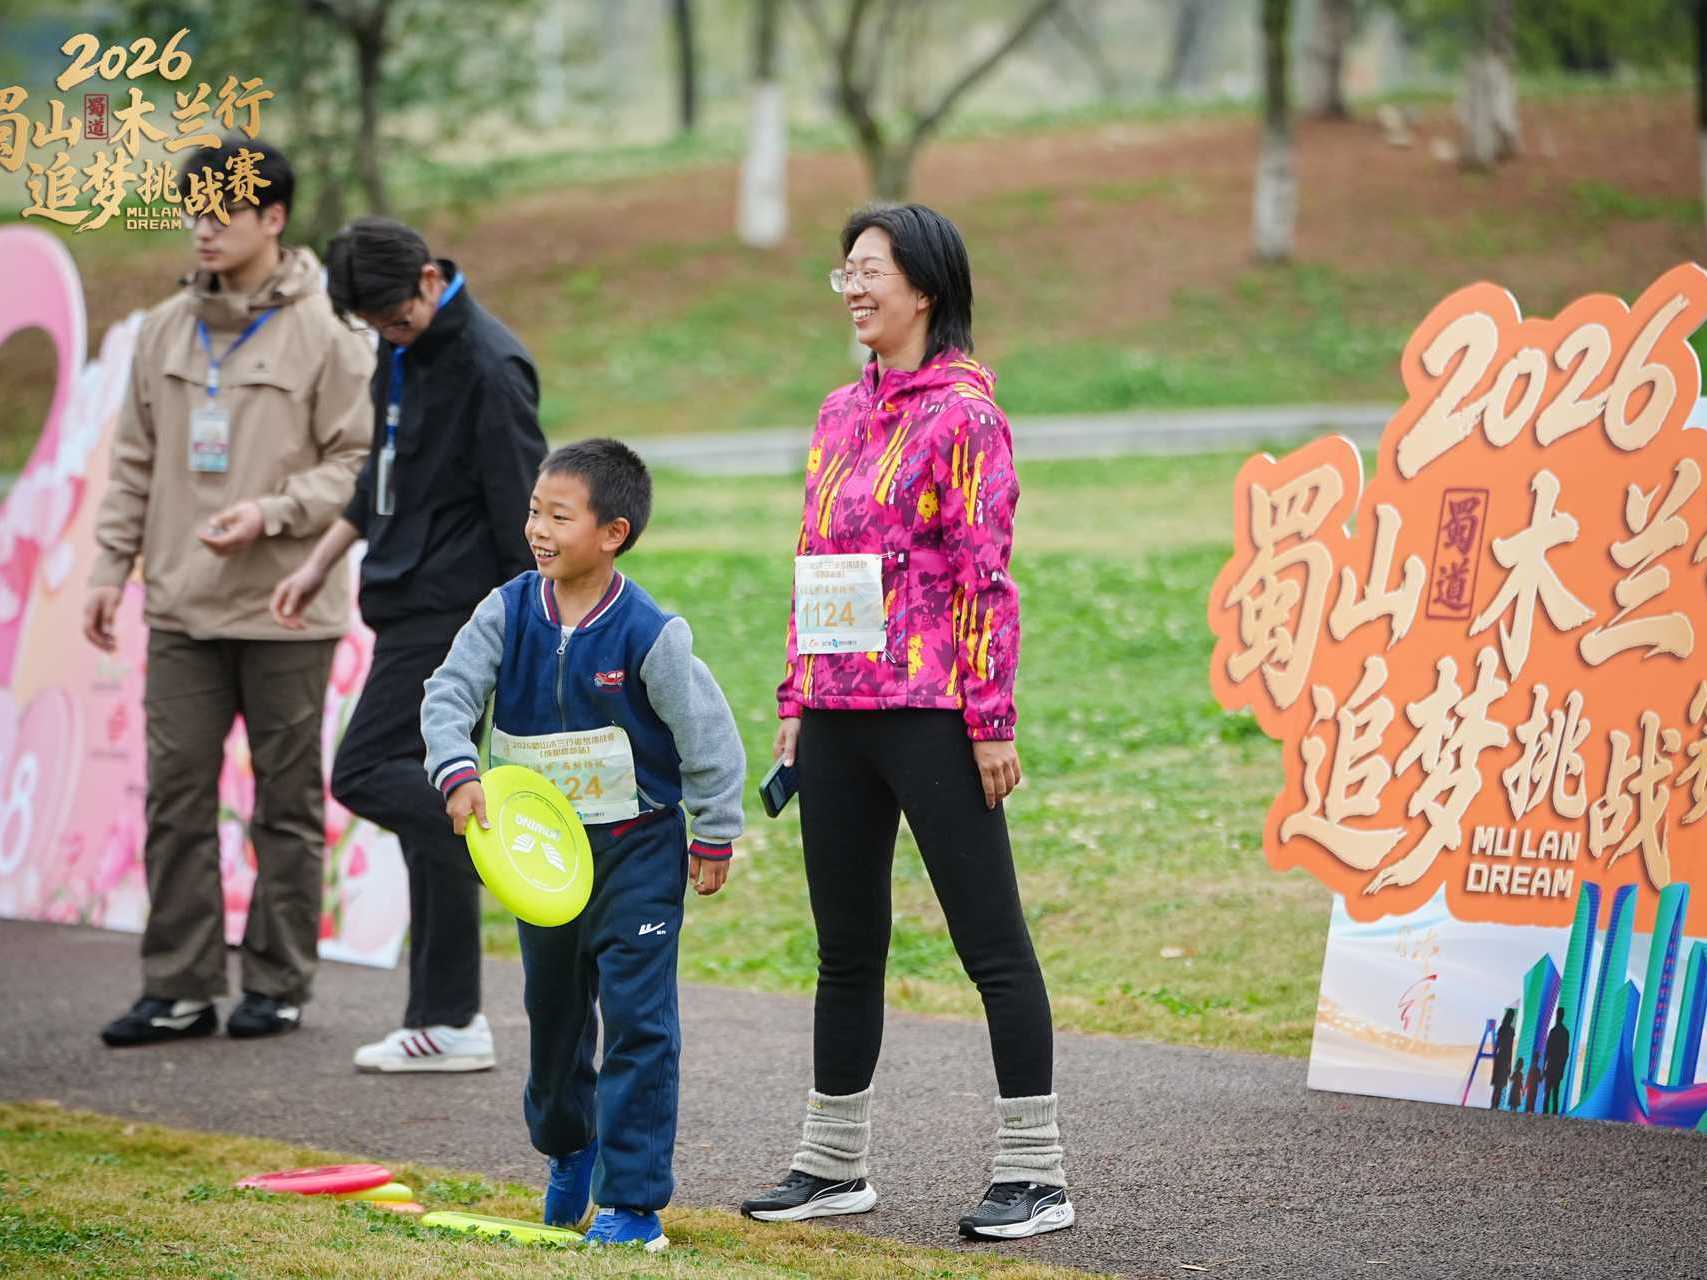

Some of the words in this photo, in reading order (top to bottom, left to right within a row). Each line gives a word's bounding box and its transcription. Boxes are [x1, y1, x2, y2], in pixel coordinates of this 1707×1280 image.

[1397, 295, 1689, 480] 2026
[1226, 458, 1707, 710] 蜀山木兰
[1434, 497, 1480, 611] 蜀道
[803, 601, 856, 627] 1124
[551, 775, 604, 800] 24
[1466, 863, 1575, 898] DREAM
